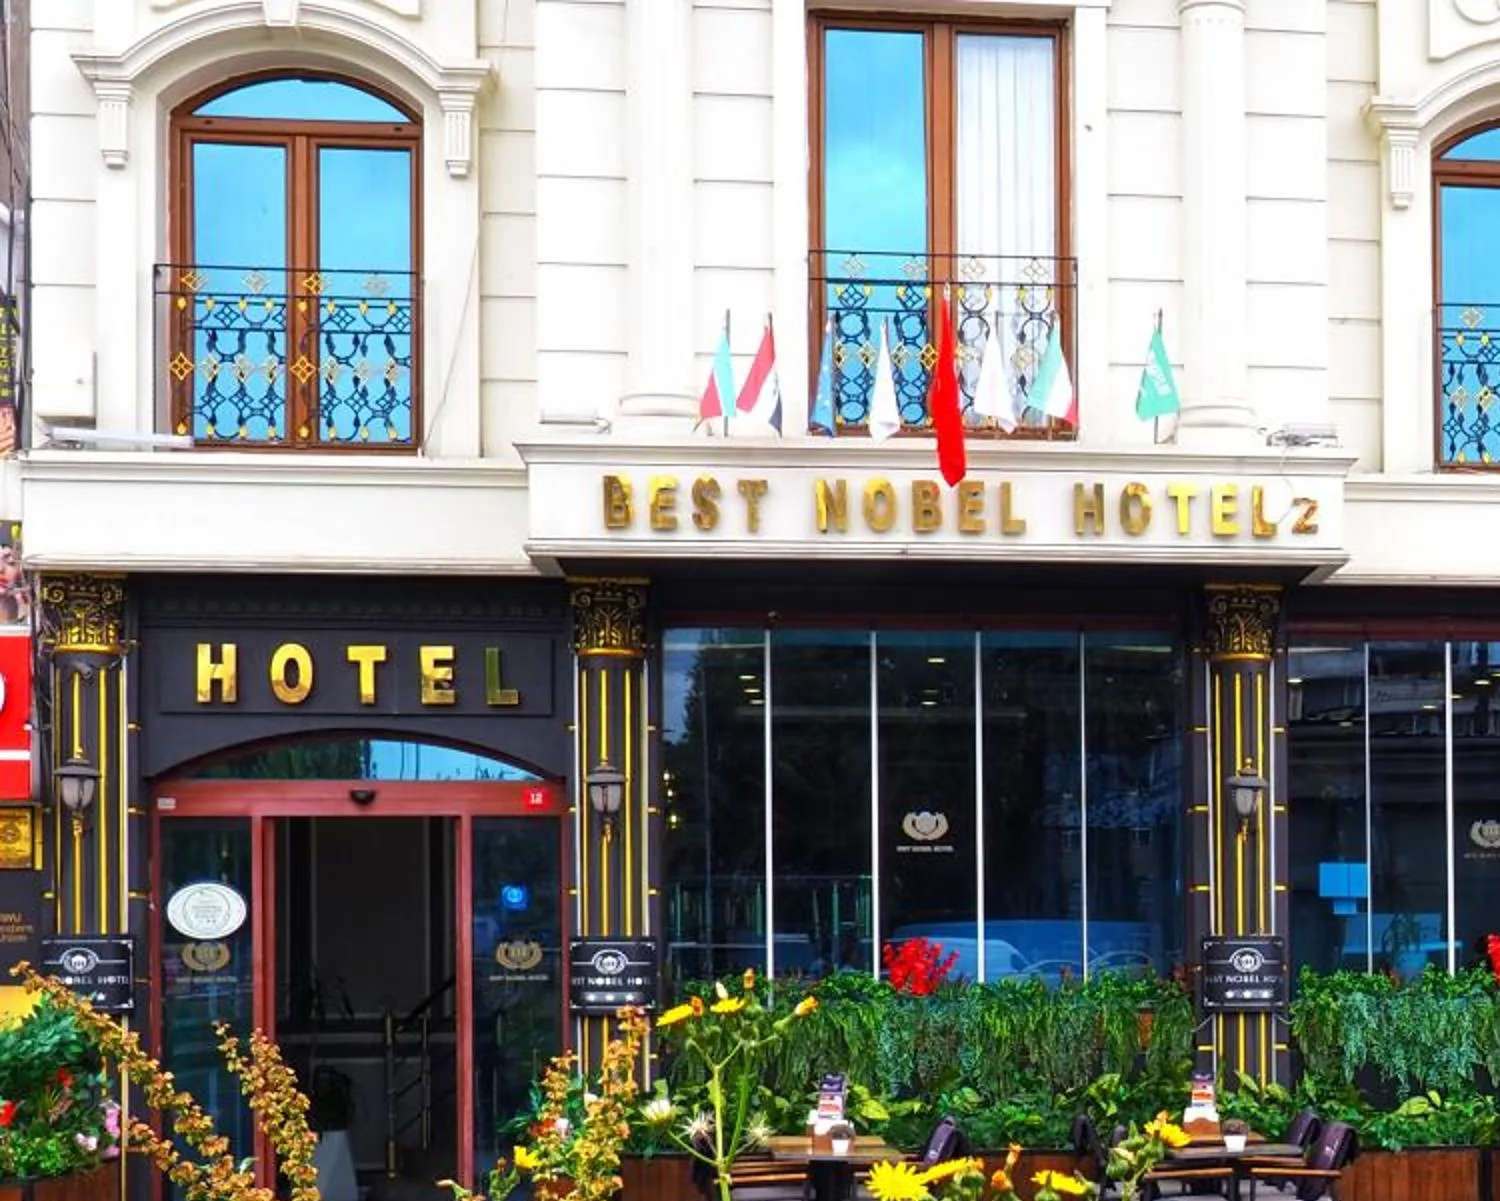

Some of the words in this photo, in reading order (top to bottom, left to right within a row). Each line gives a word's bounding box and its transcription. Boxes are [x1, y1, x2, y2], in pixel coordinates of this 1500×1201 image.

[603, 475, 769, 533] BEST
[815, 479, 1026, 534] NOBEL
[1074, 481, 1278, 537] HOTEL
[197, 643, 519, 705] HOTEL
